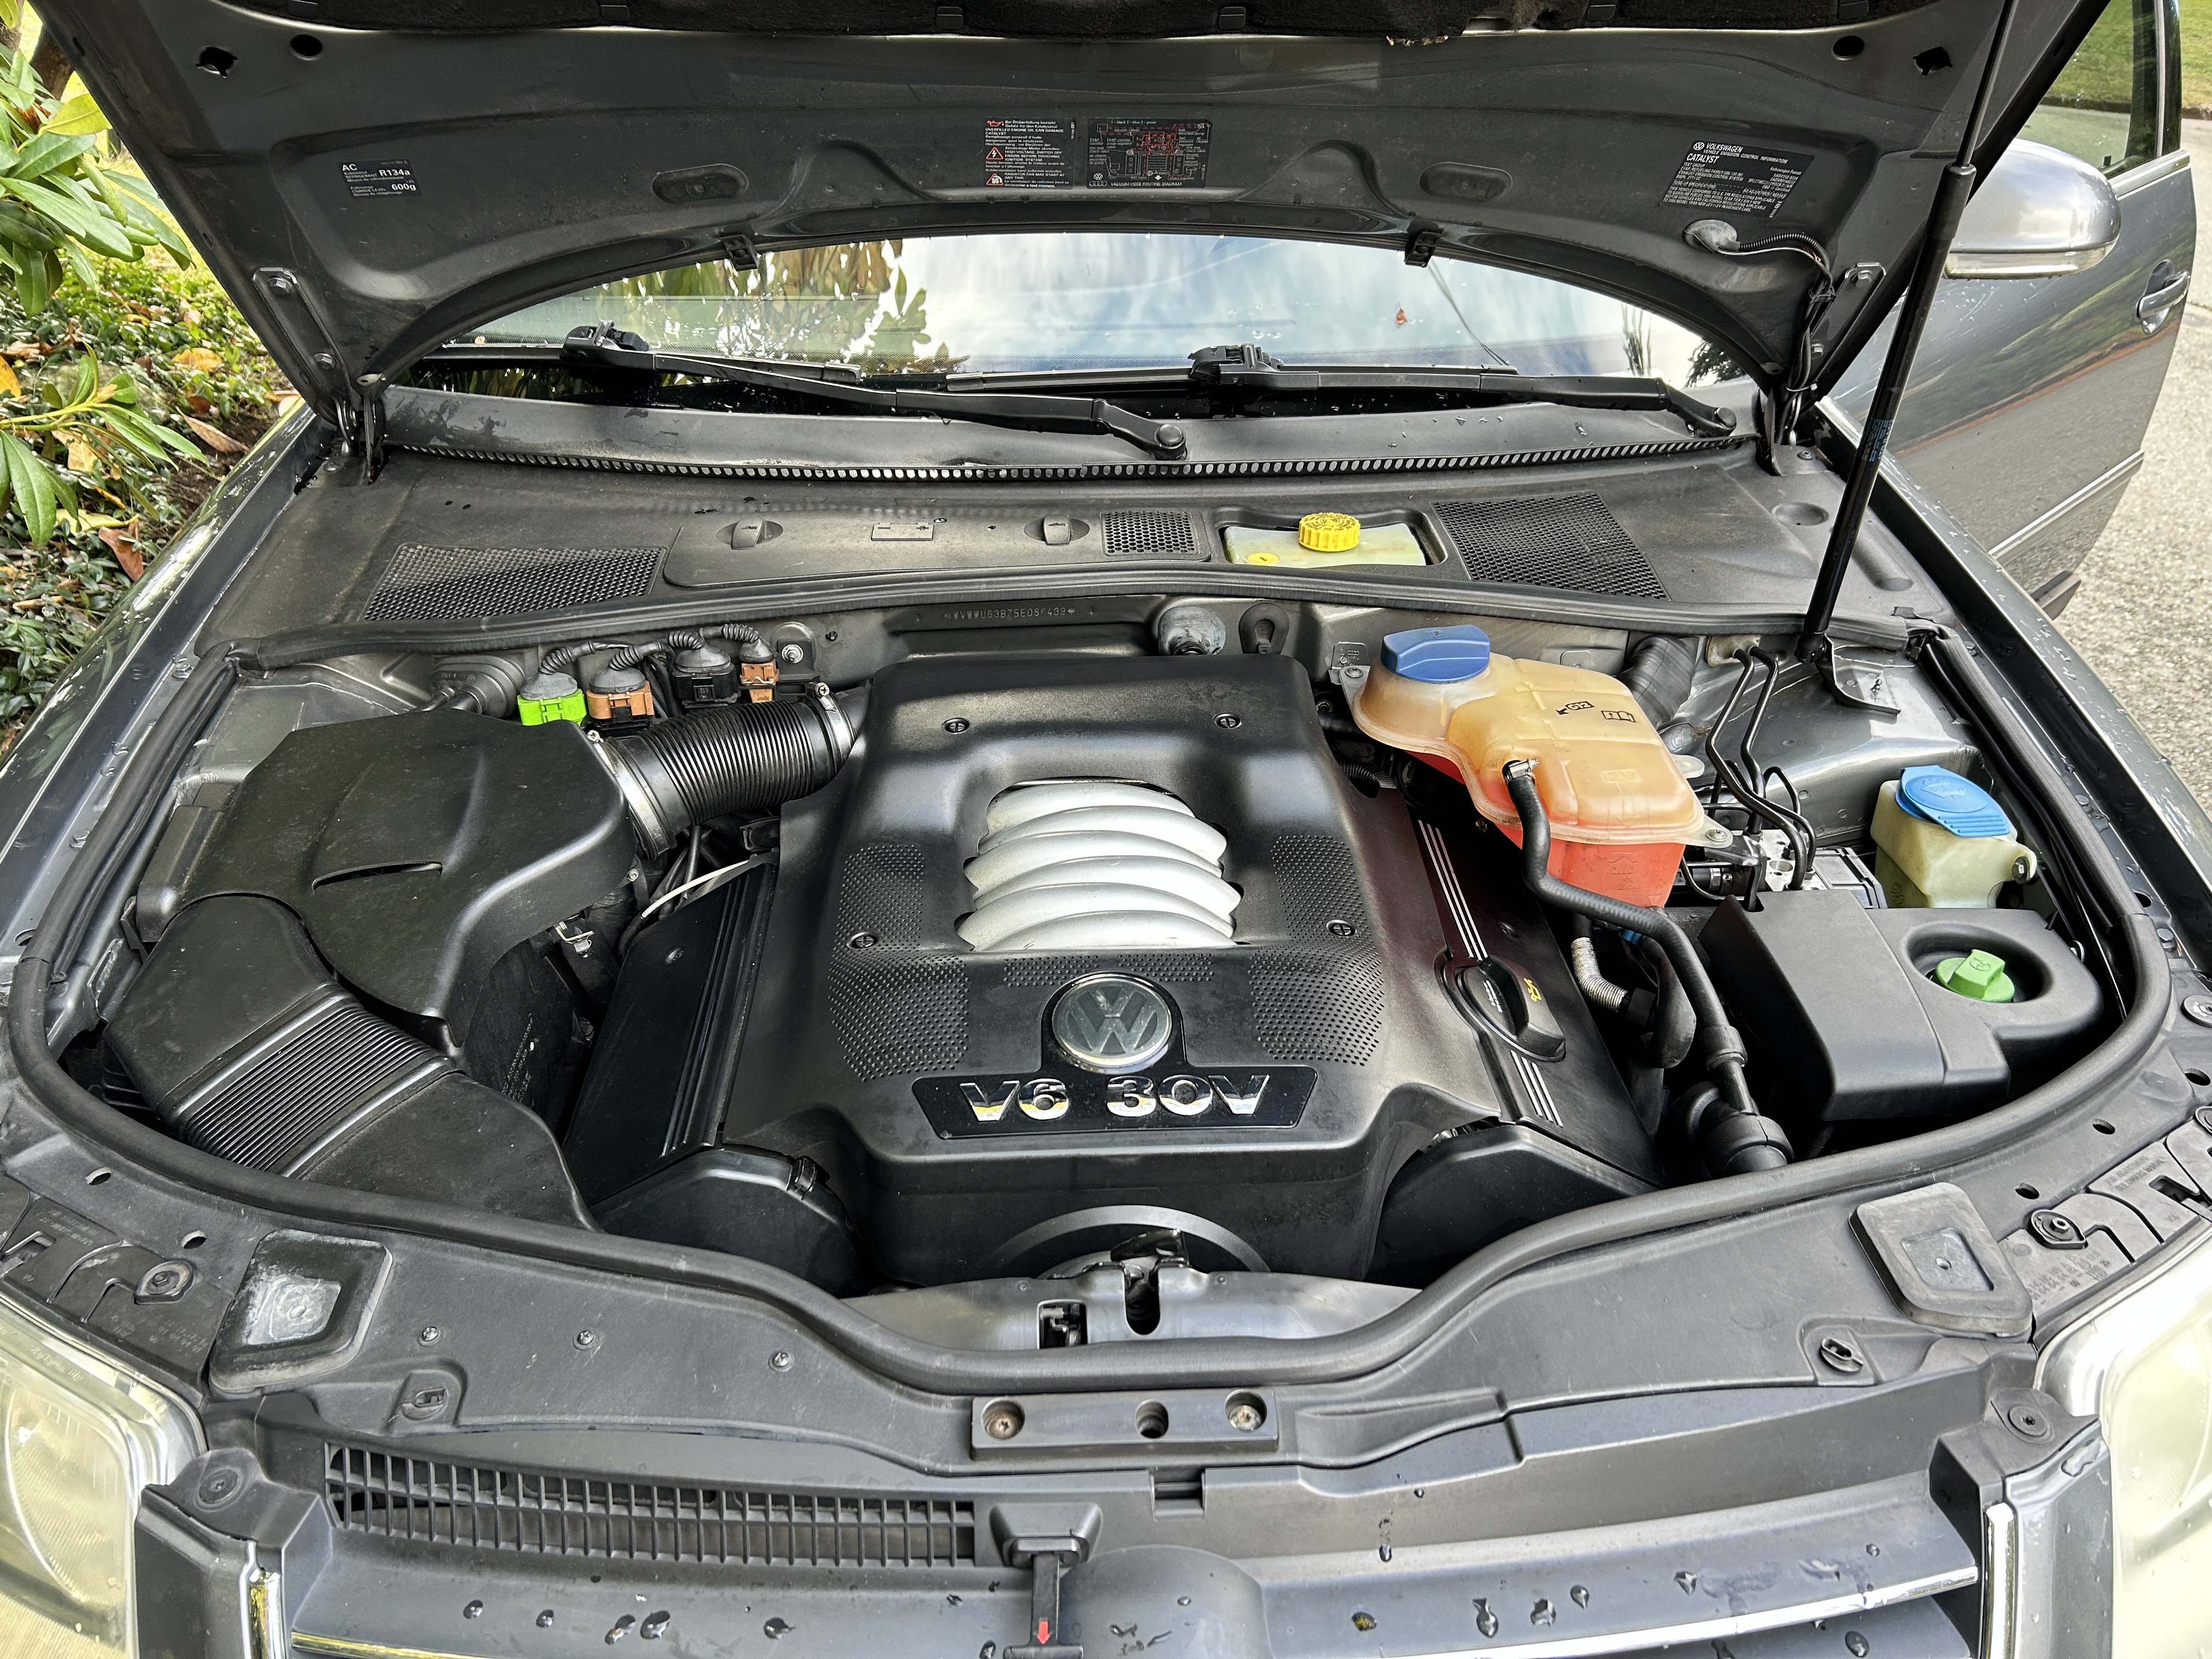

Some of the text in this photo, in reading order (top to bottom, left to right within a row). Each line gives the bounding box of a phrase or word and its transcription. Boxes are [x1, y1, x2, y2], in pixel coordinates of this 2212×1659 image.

[1706, 143, 1743, 153] VOLKSWAGEN
[1686, 153, 1719, 164] CATALYST
[1760, 156, 1788, 164] INFORMATION
[1567, 702, 1592, 710] G12
[961, 1074, 1270, 1122] V6 30V
